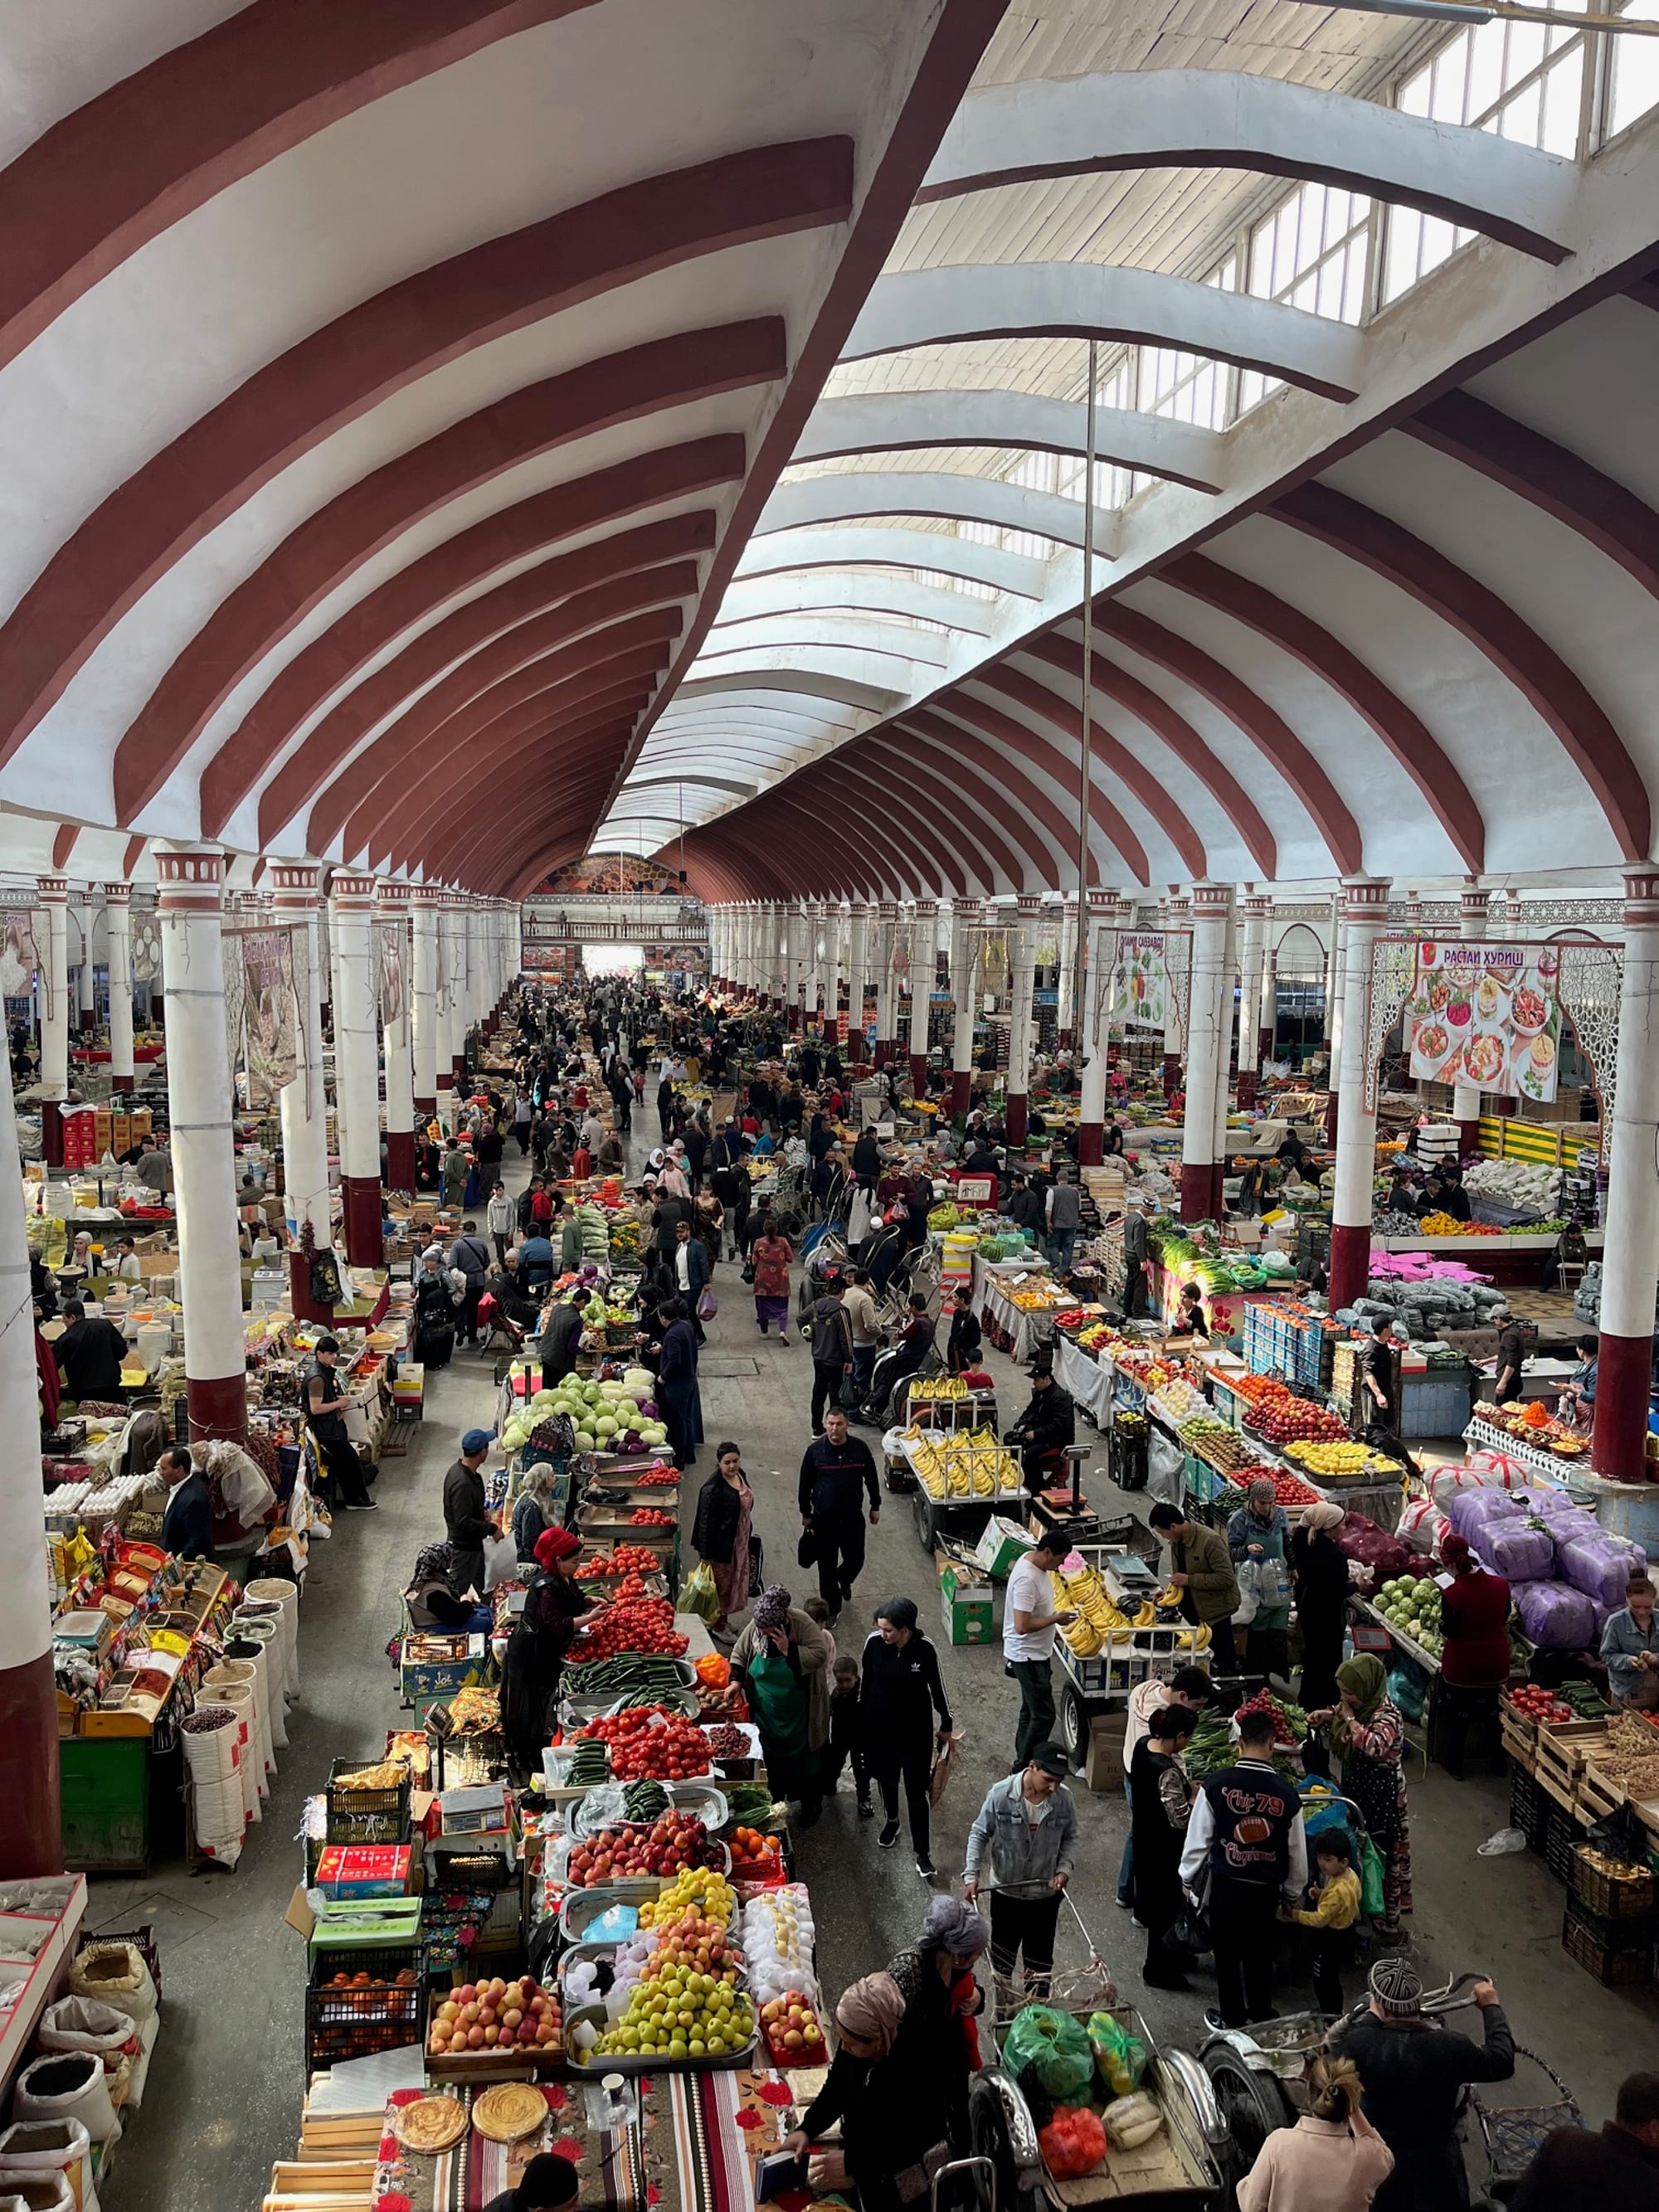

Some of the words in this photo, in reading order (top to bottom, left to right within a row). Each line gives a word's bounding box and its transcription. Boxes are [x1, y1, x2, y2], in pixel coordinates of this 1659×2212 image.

[1444, 950, 1481, 963] РАСТАИ
[1221, 1787, 1256, 1815] Chic
[1255, 1792, 1285, 1817] 79
